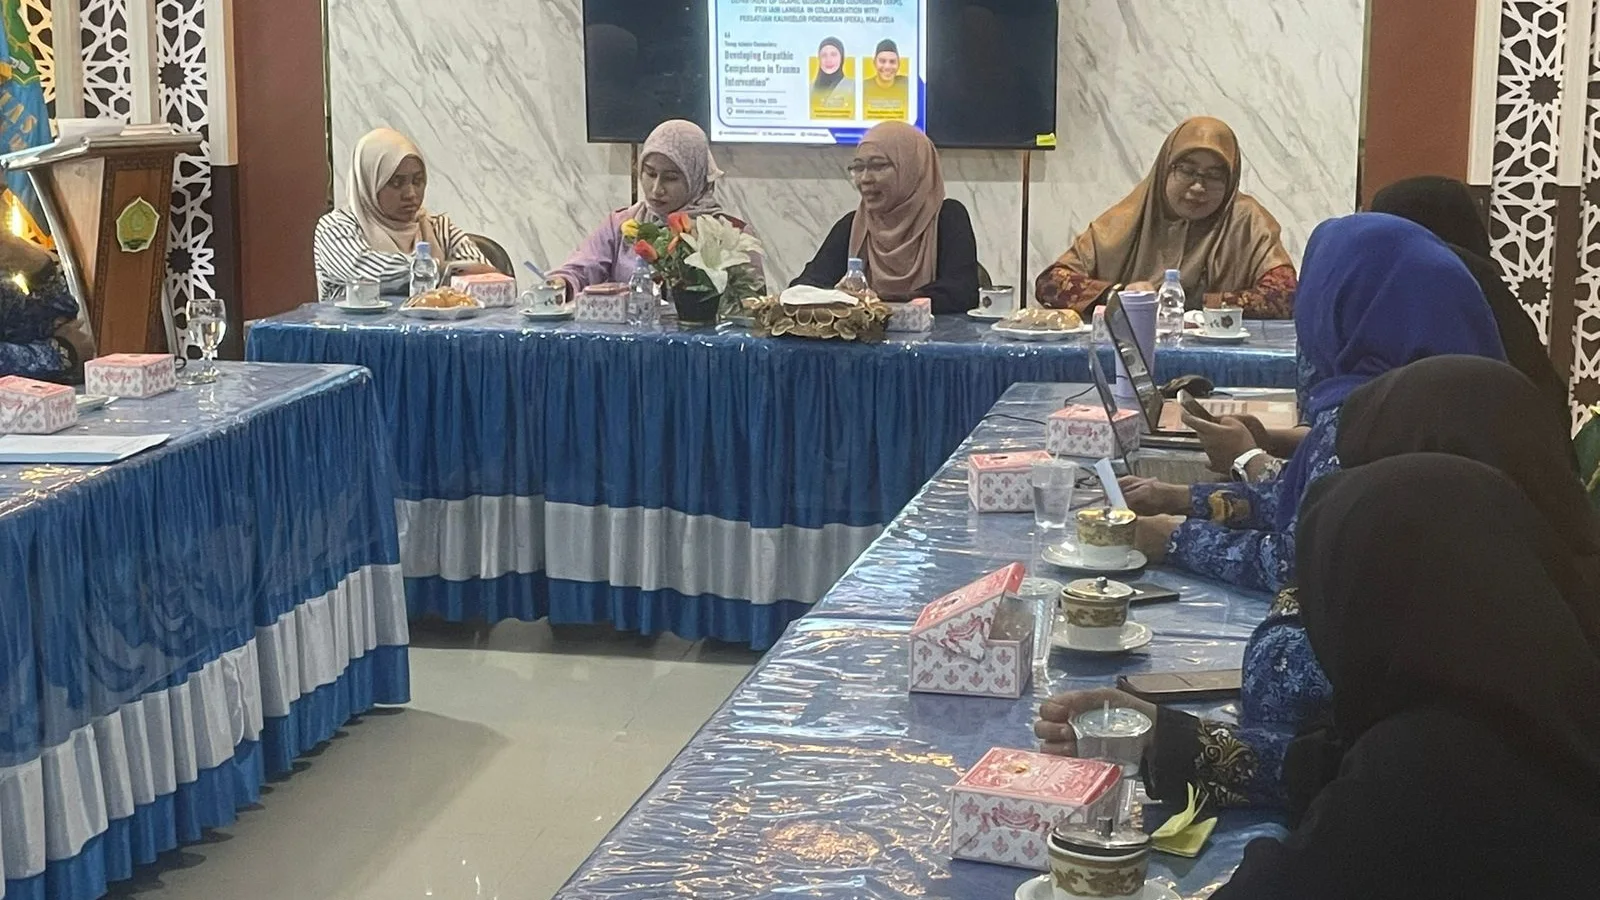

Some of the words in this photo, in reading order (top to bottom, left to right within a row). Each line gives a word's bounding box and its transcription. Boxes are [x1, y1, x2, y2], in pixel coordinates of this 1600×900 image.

[724, 50, 761, 61] Developing
[762, 50, 794, 62] Empathic
[725, 63, 766, 75] Competence
[767, 64, 774, 73] in
[775, 64, 800, 74] Trauma
